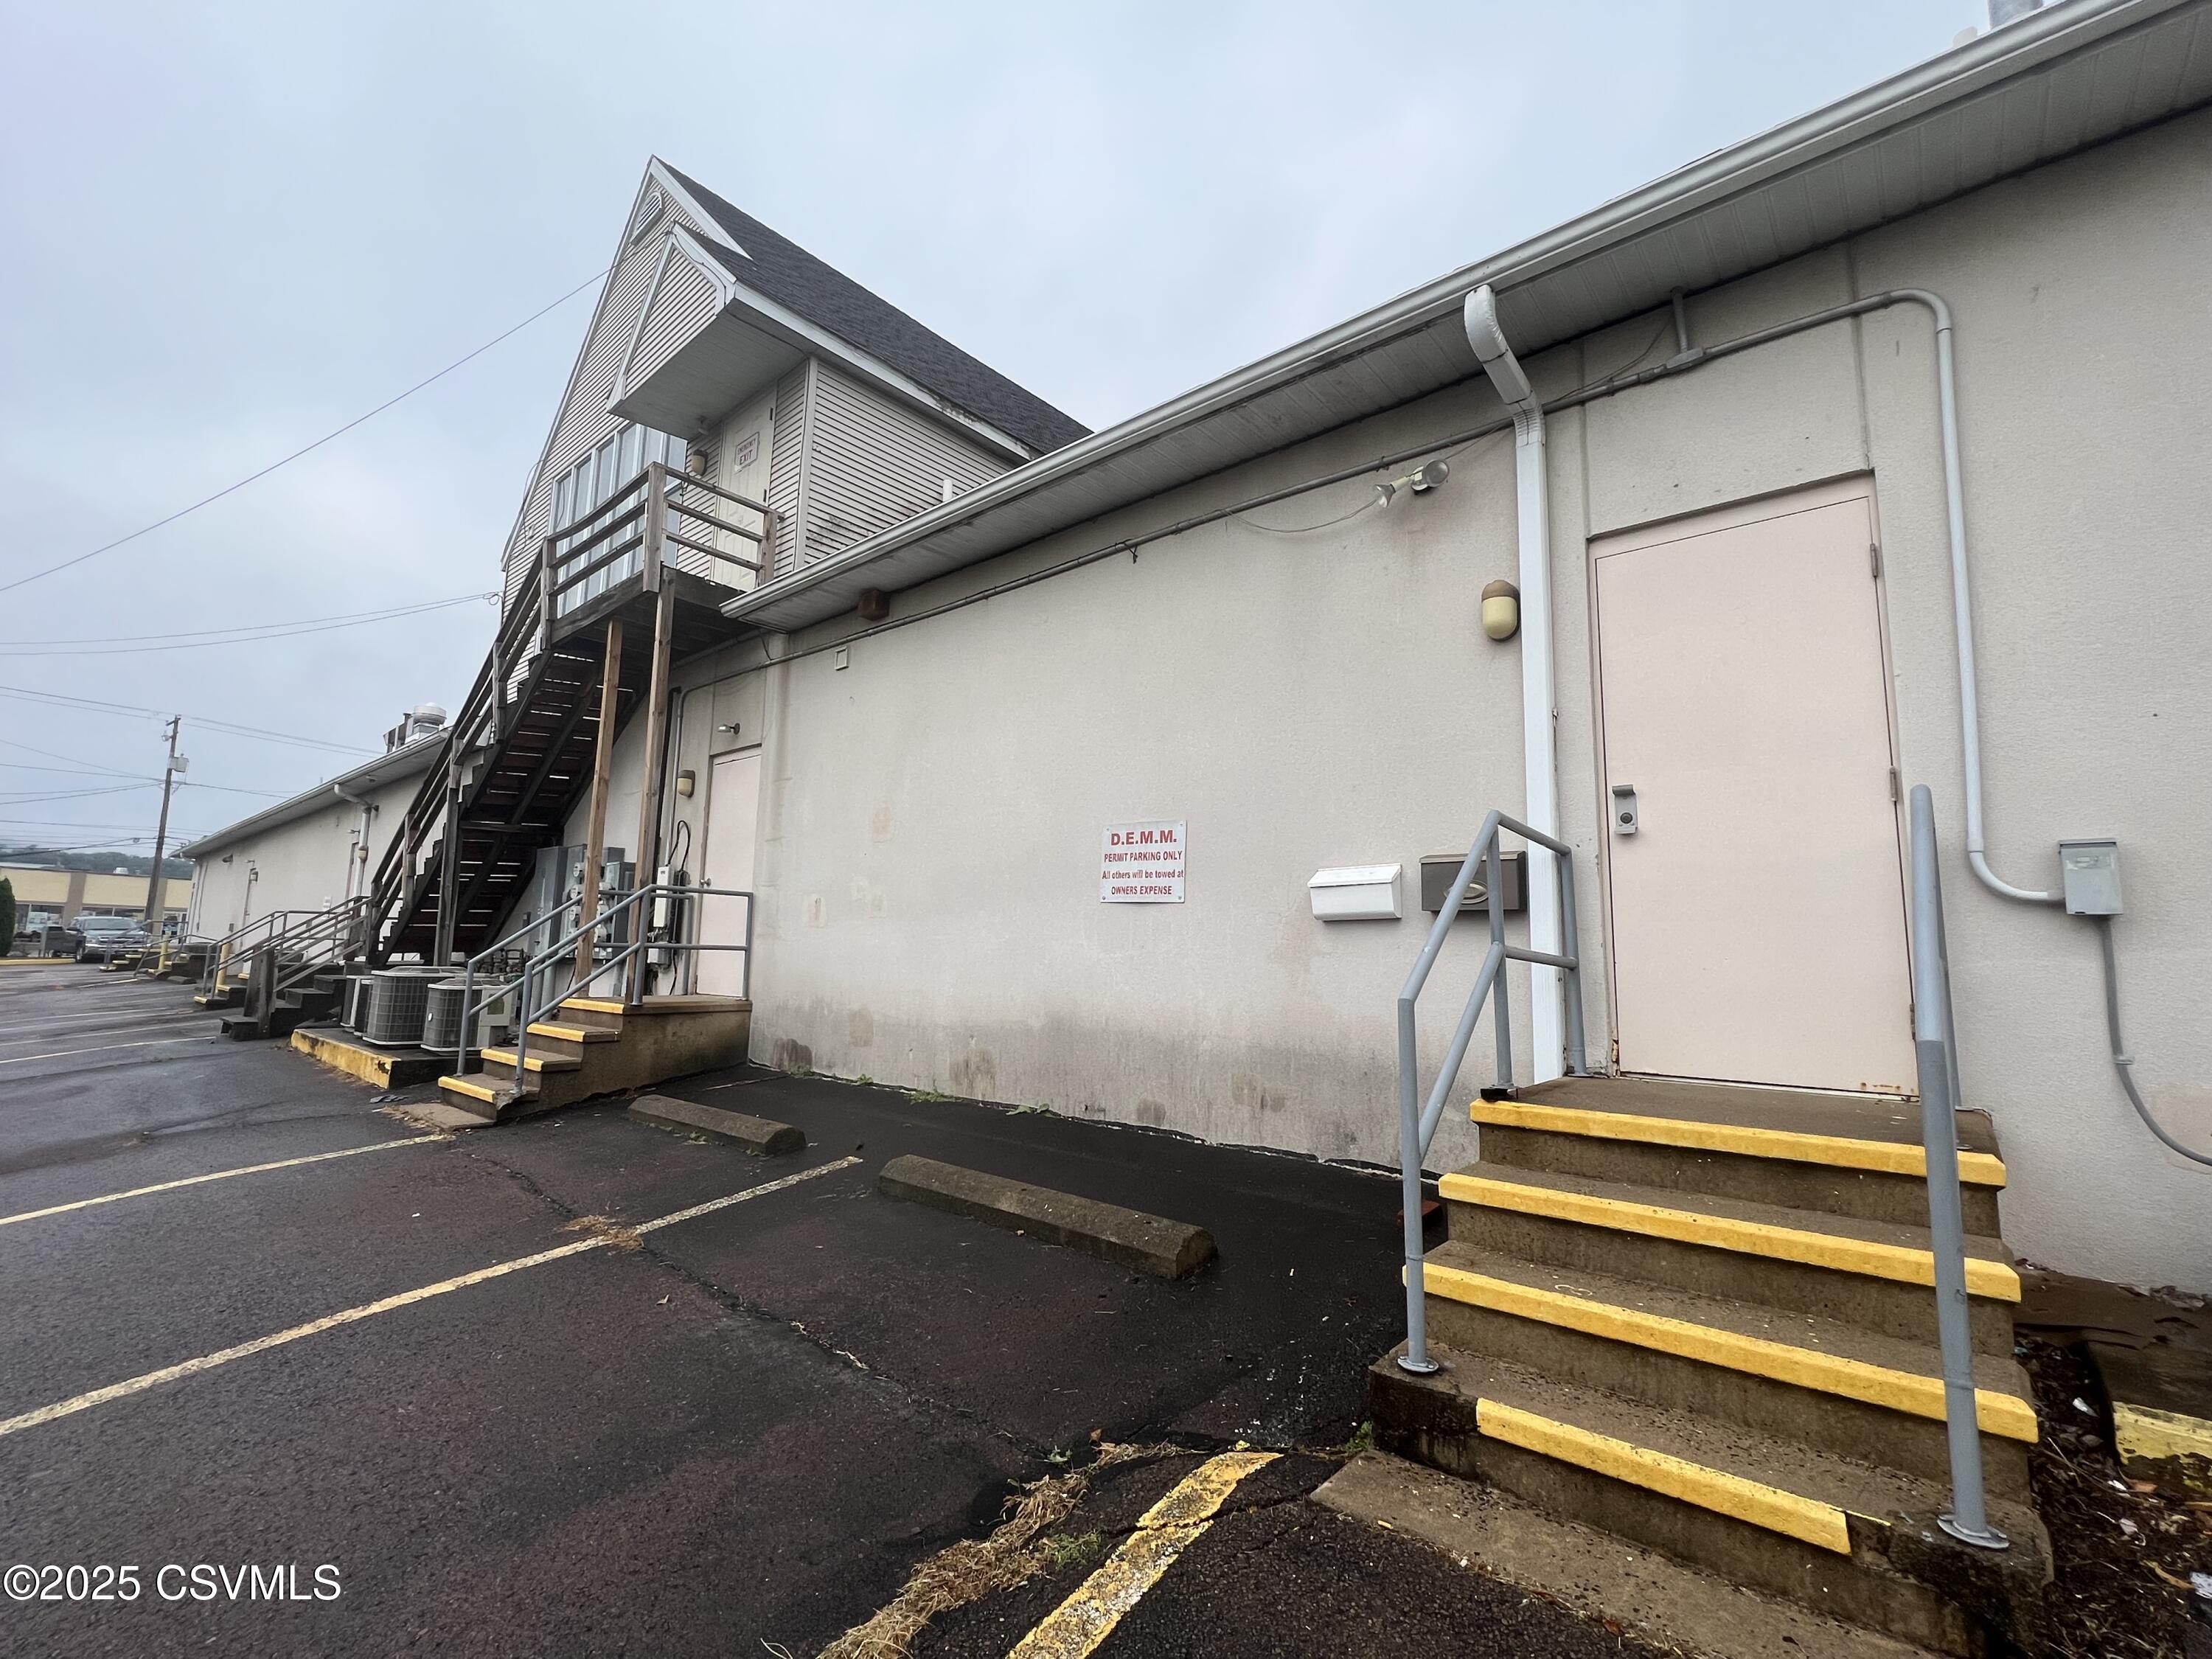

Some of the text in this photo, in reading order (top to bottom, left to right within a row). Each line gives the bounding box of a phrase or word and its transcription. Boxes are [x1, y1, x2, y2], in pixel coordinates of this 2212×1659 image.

[740, 449, 753, 465] EXIT
[1110, 830, 1177, 846] D.E.M.M.
[1105, 850, 1183, 863] PERMIT PARKING ONLY
[1102, 869, 1184, 880] All others will be towed at
[1111, 886, 1172, 895] OWNERS EXPENSE
